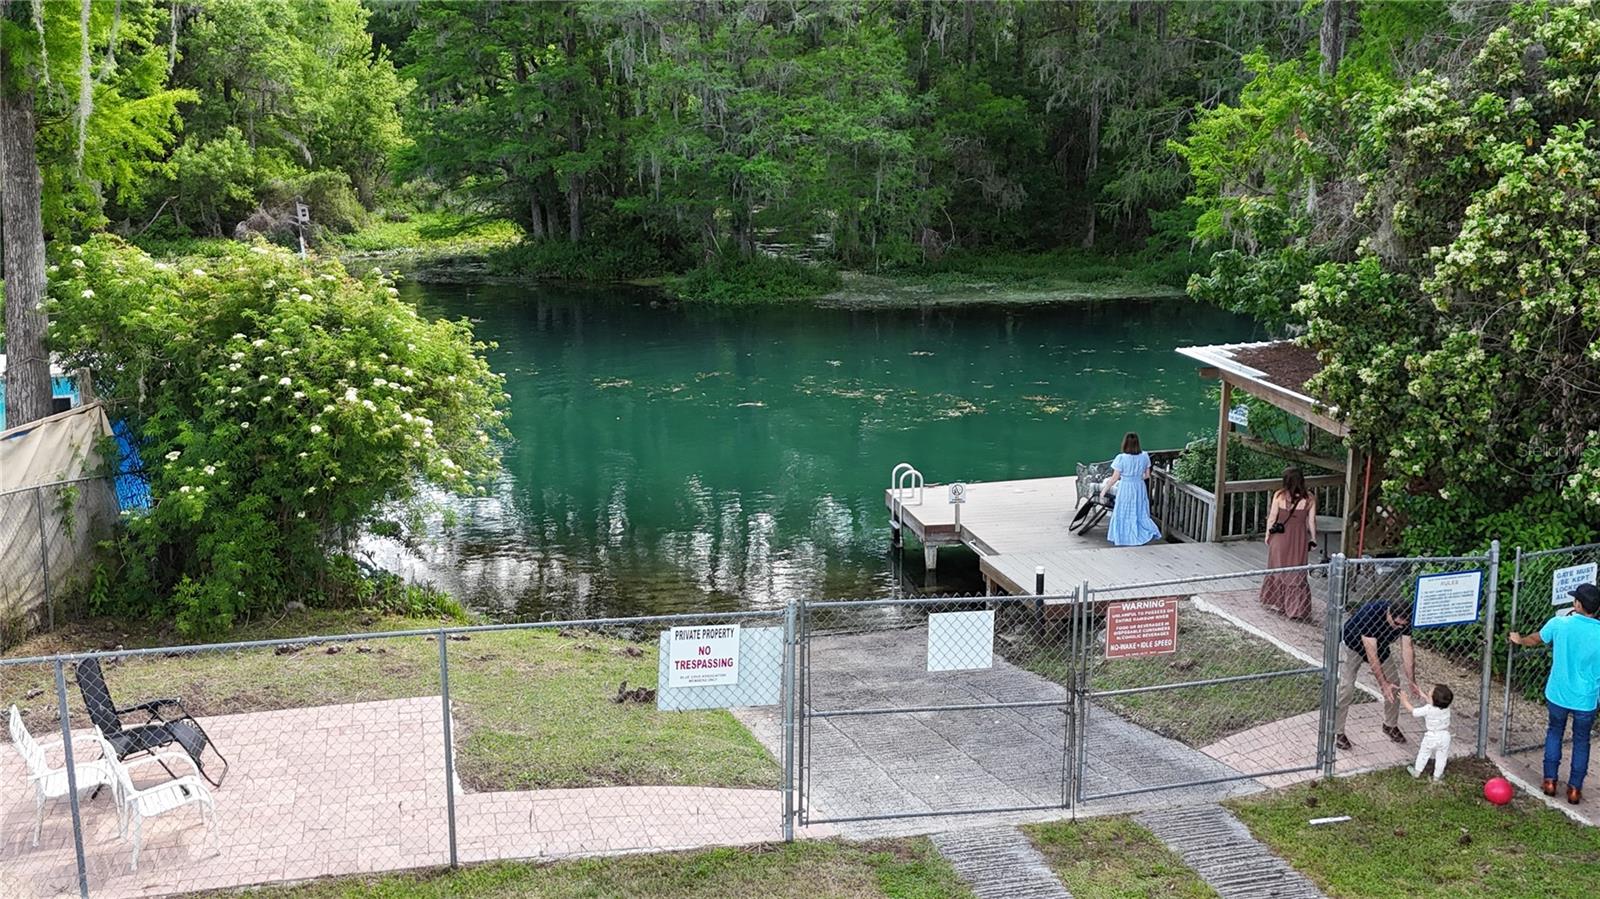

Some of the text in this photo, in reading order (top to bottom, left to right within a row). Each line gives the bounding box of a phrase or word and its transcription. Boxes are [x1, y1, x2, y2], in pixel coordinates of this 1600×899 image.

[1556, 566, 1594, 579] GATE MUST
[1572, 574, 1590, 582] KEPT
[1122, 600, 1165, 610] WARNING
[675, 627, 735, 640] PRIVATE PROPERTY
[698, 645, 711, 656] NO
[1110, 640, 1172, 650] NO-WAKE IDLE SPEED
[675, 657, 734, 670] TRESPASSING
